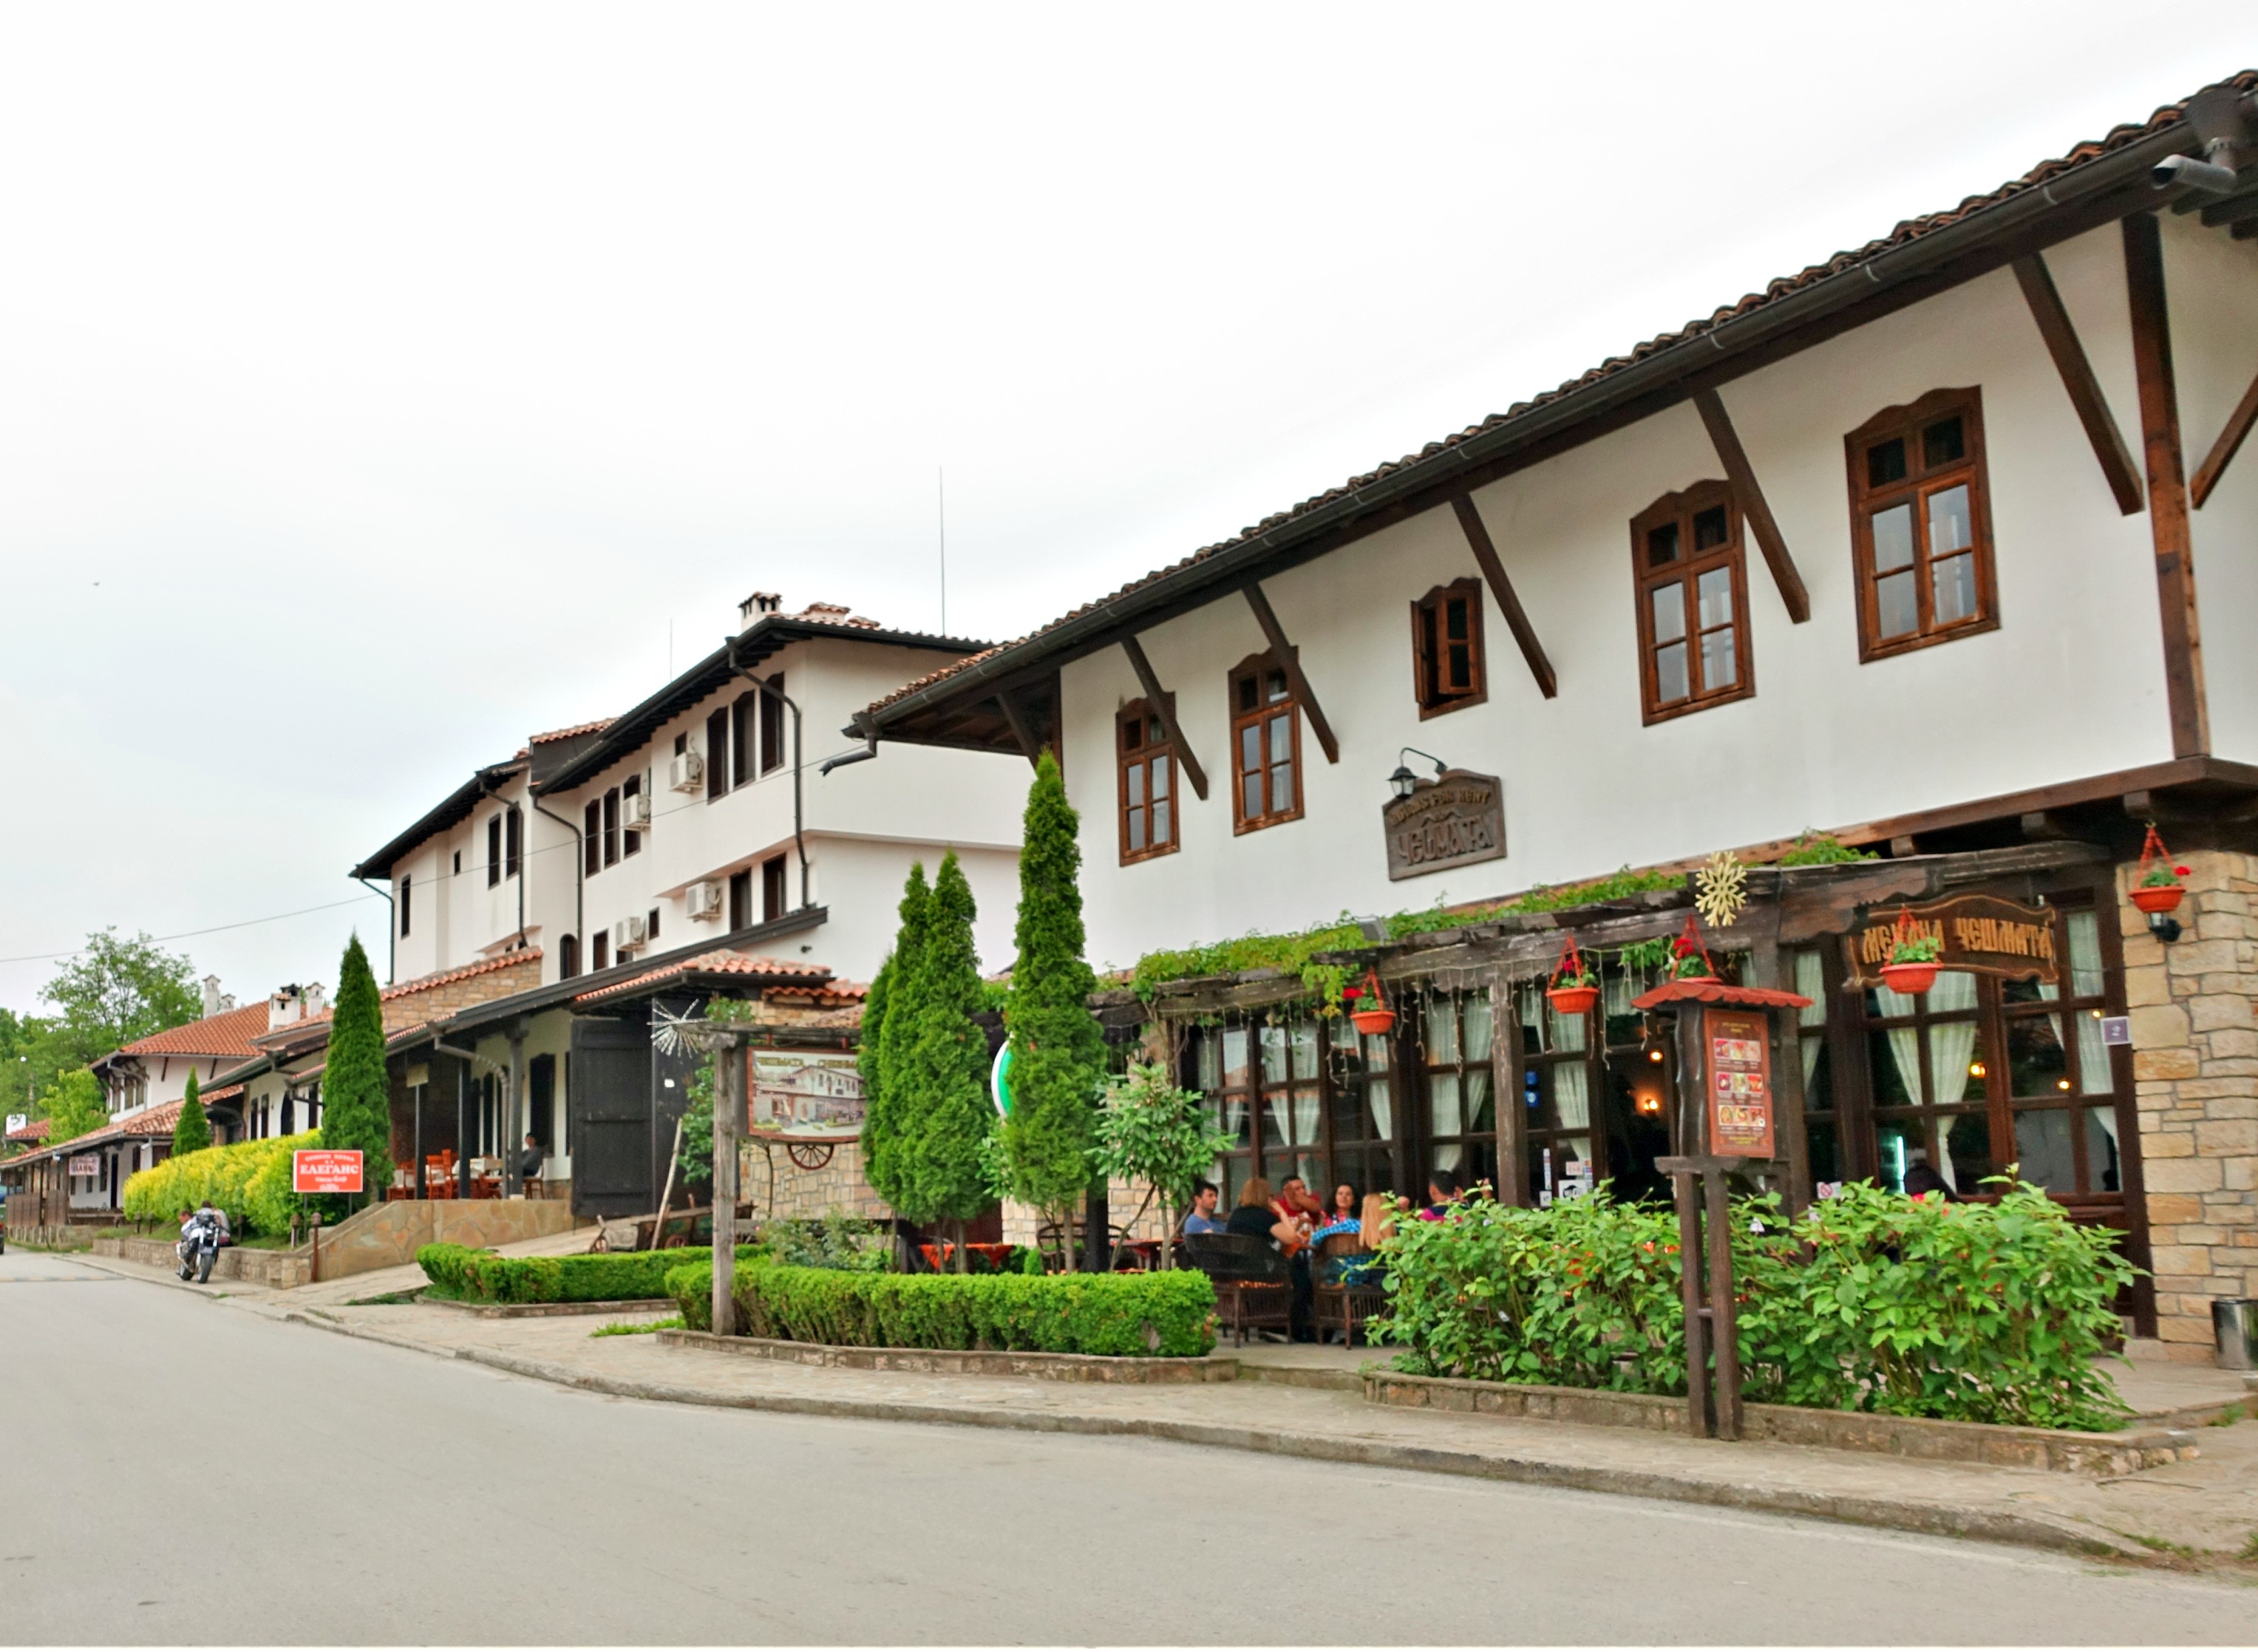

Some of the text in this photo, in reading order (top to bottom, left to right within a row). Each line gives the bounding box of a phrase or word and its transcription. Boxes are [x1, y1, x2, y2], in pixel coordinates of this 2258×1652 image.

[1459, 789, 1492, 805] RENT
[1956, 918, 2053, 959] ЧЕШМАТА
[300, 1164, 359, 1175] ЕЛЕГАНС
